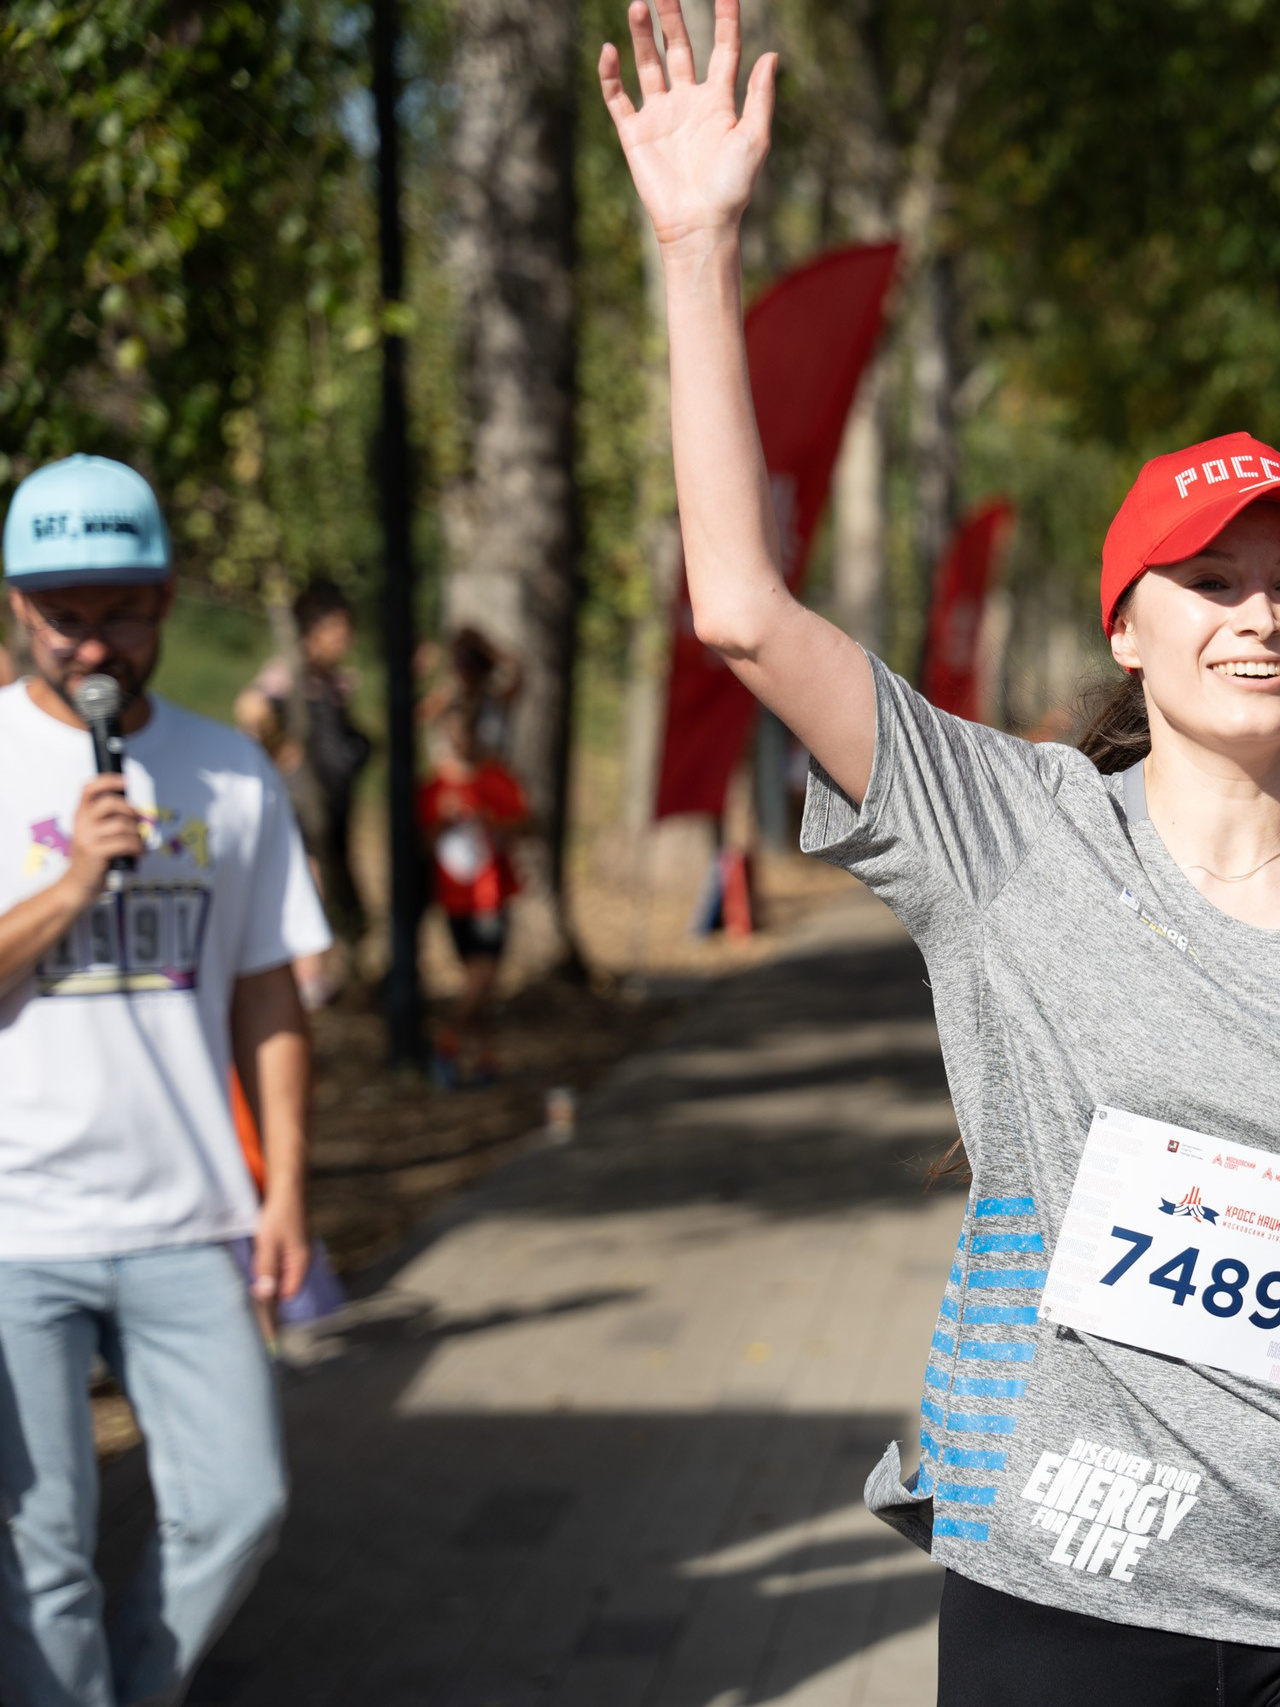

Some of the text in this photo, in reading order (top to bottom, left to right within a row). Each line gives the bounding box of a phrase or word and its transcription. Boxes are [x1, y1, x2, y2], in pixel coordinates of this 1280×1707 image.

[1223, 1162, 1239, 1172] СПОРТ
[1225, 1156, 1257, 1170] МОСКОВСКИЙ
[1225, 1205, 1256, 1224] КРОСС
[1222, 1221, 1265, 1238] МОСКОВСКИЙ
[1068, 1438, 1201, 1495] DISCOVER YOUR
[1020, 1451, 1200, 1541] ENERGY
[1031, 1507, 1150, 1583] FOR LIFE
